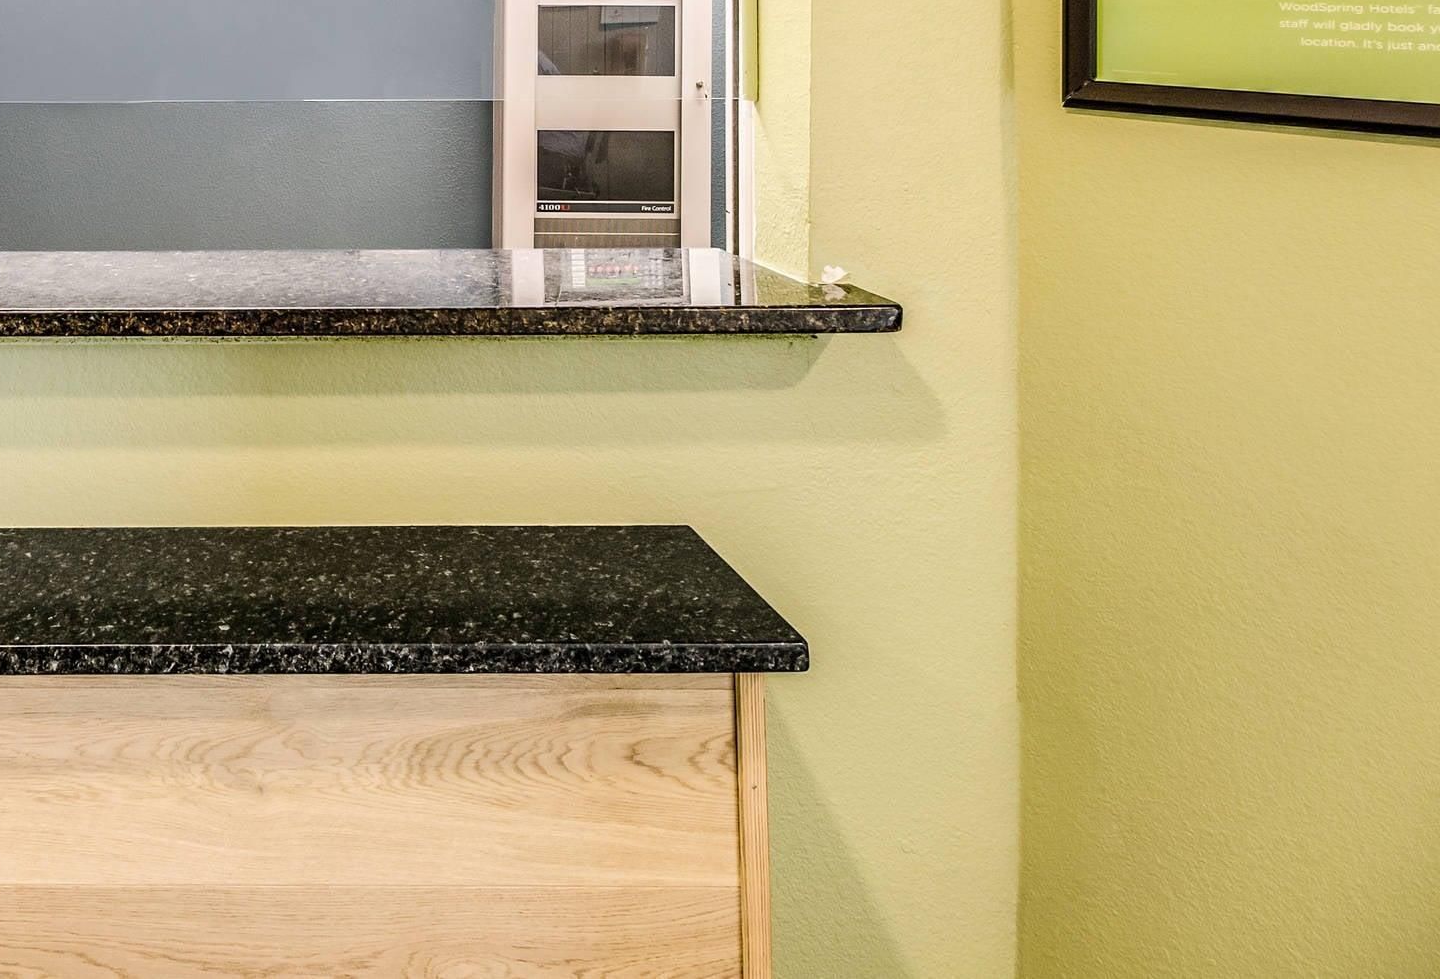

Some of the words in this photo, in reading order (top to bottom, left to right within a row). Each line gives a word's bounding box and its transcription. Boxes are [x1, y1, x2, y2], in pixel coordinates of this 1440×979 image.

[1279, 2, 1363, 14] WoodSpring
[1279, 19, 1308, 29] staff
[1312, 20, 1335, 30] will
[1339, 22, 1382, 33] gladly
[1387, 22, 1425, 33] book
[1386, 40, 1413, 51] just
